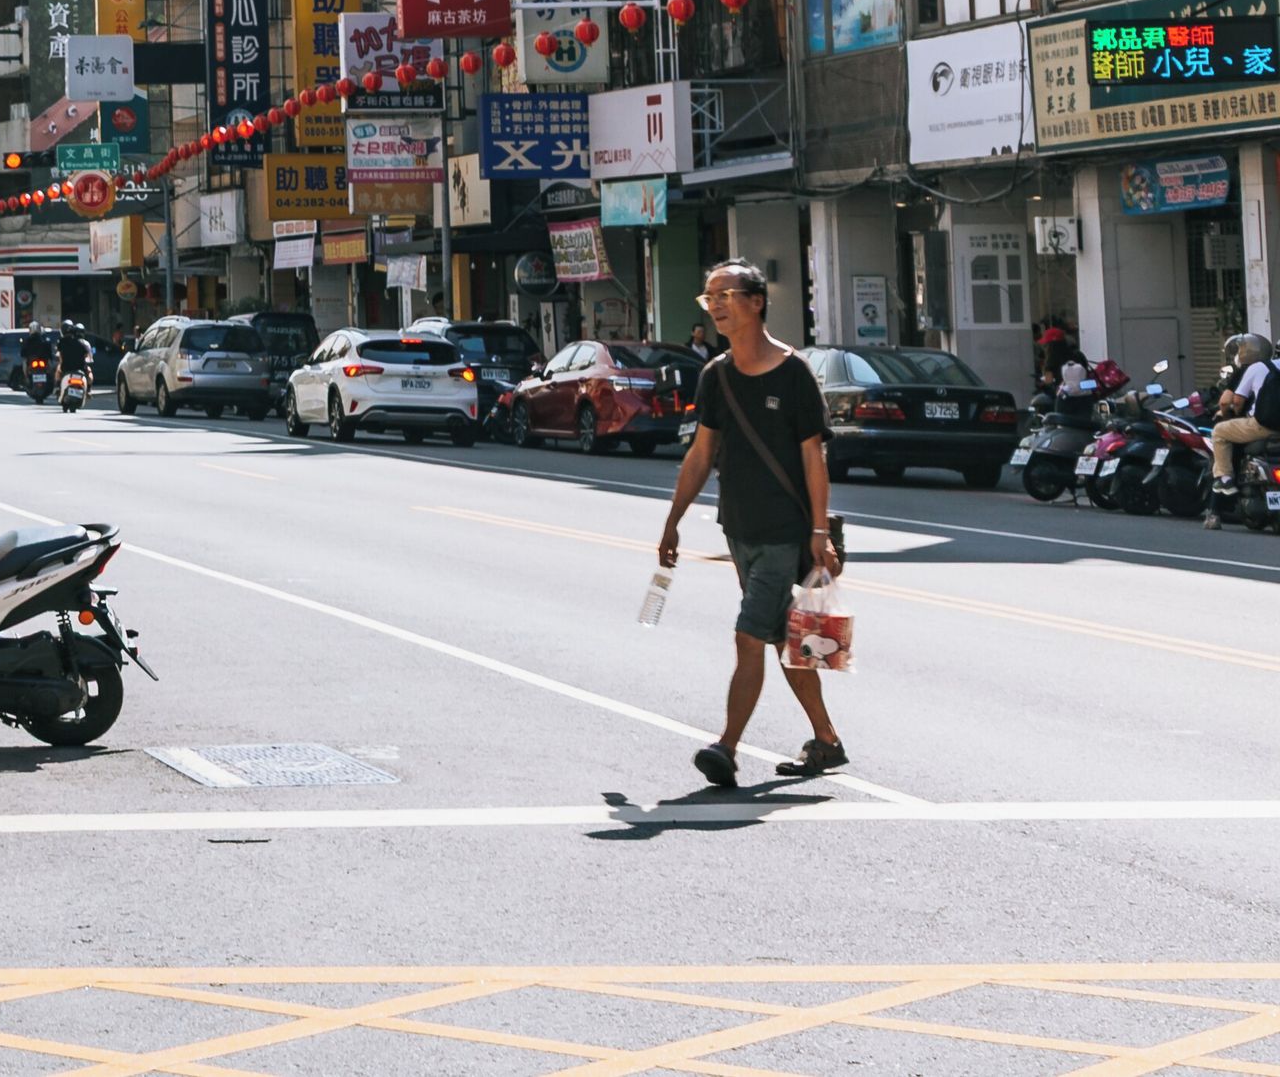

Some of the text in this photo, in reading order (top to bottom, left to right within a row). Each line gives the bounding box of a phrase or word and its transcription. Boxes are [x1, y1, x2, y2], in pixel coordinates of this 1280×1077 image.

[427, 9, 488, 27] 麻古茶坊
[66, 147, 111, 159] 文昌街
